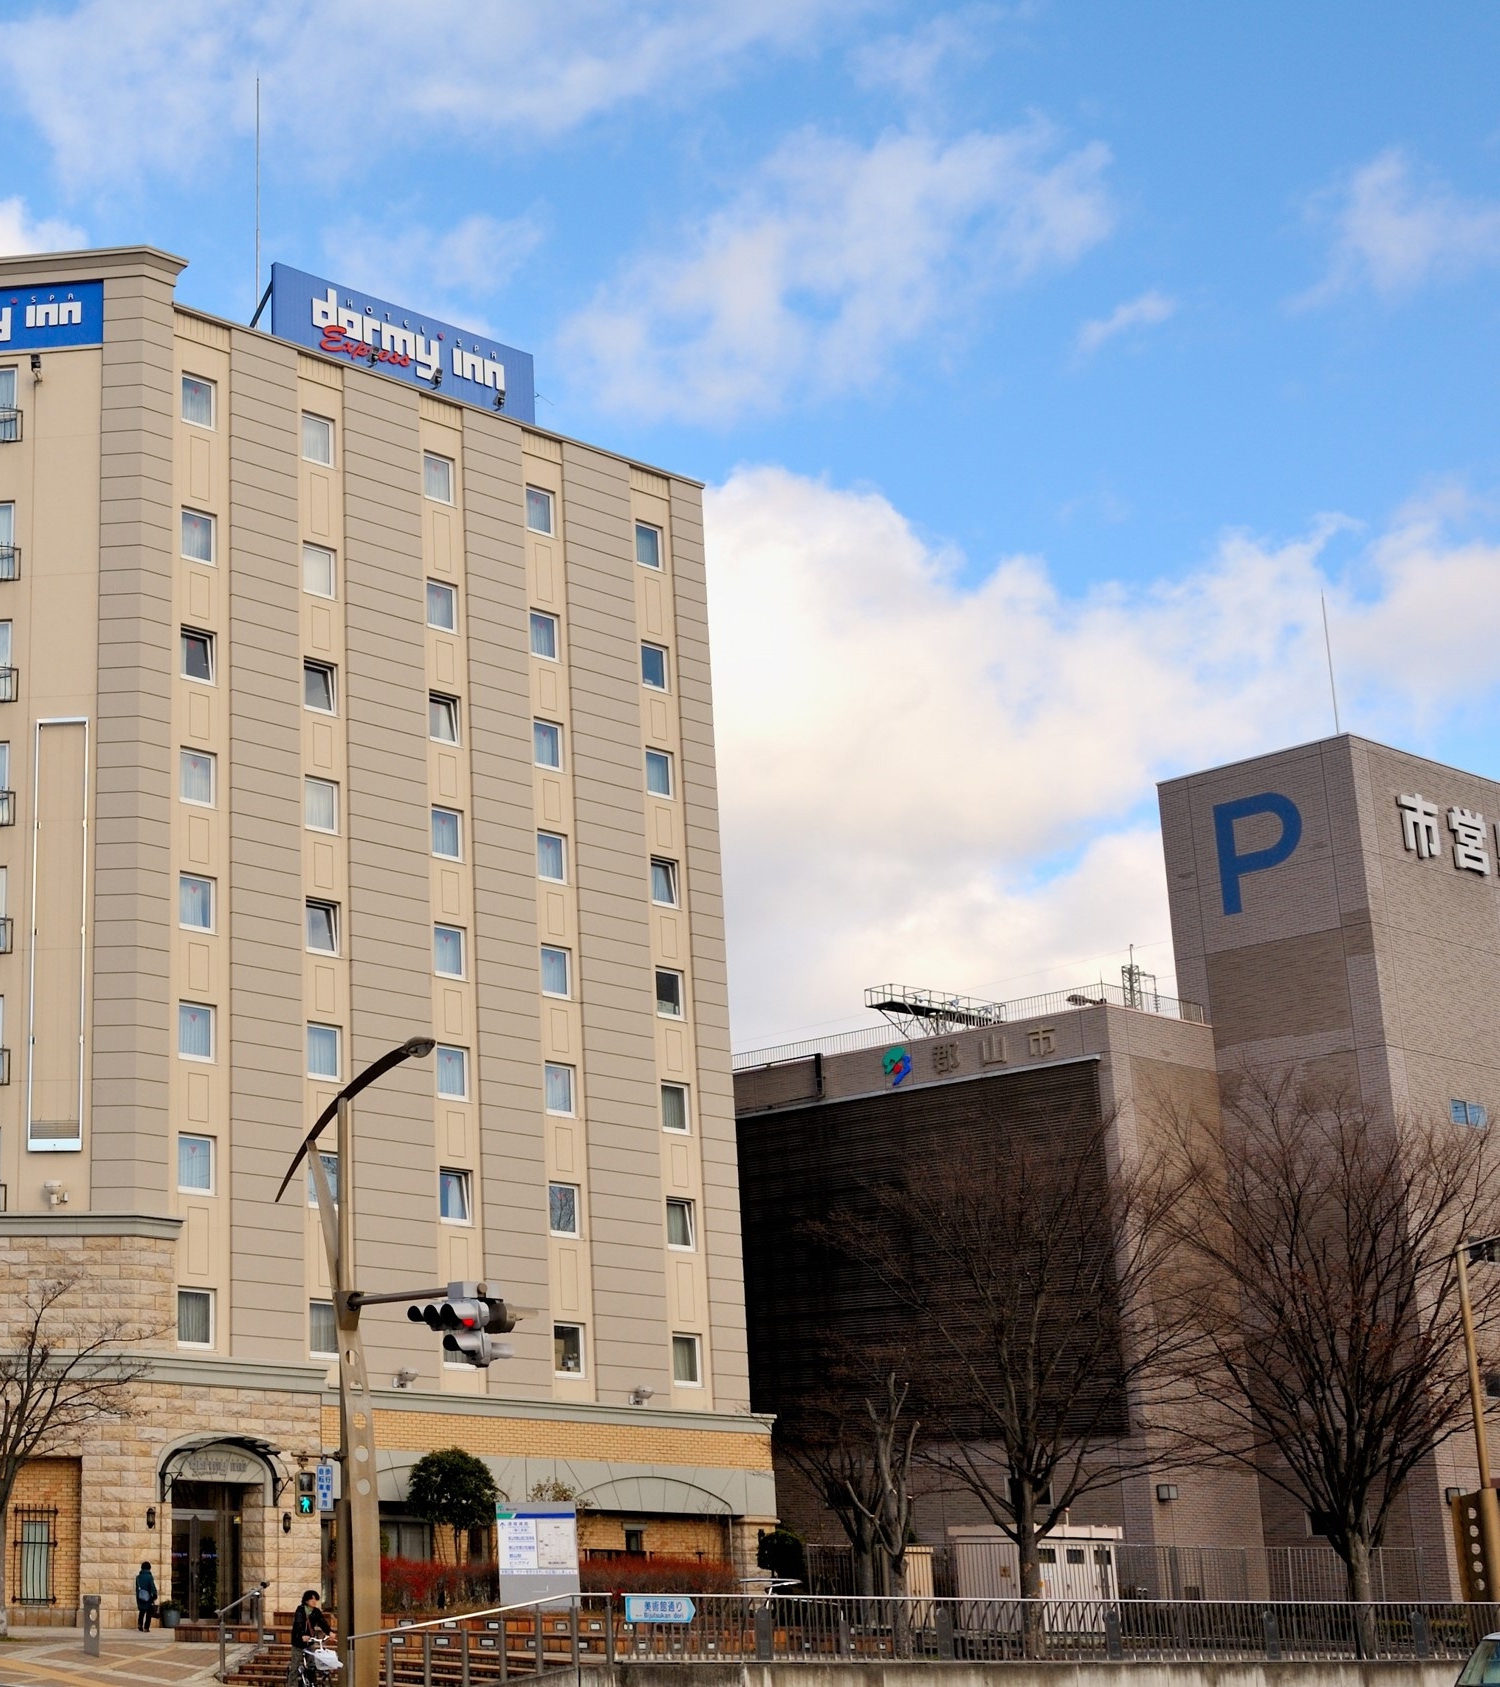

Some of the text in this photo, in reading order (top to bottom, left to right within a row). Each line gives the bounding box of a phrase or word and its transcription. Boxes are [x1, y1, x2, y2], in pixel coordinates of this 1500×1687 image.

[26, 302, 82, 328] inn
[31, 293, 74, 304] SPA
[312, 288, 505, 391] dormy inn
[320, 325, 411, 367] Expess
[346, 299, 497, 360] HOTEL SPA
[1213, 791, 1302, 916] P
[1396, 793, 1500, 876] 市営
[932, 1025, 1056, 1075] 郡山市
[644, 1601, 683, 1612] 美術館通り
